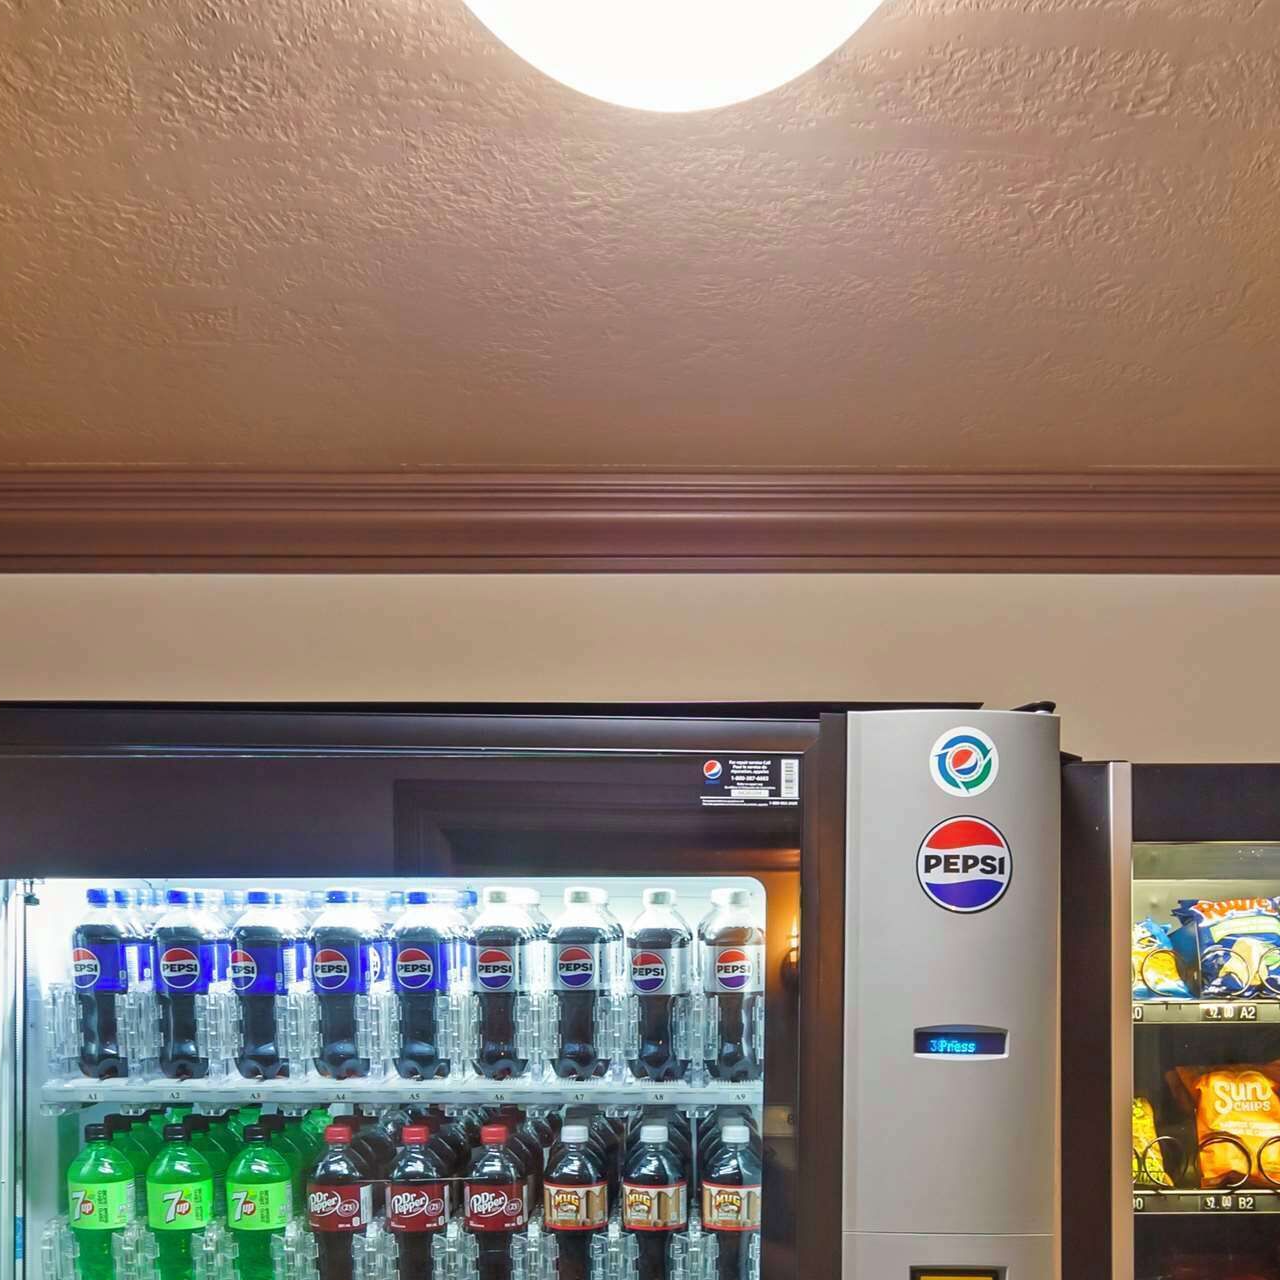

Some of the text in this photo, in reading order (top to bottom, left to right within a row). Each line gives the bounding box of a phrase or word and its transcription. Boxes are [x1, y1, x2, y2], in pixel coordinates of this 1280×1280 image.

[924, 855, 1005, 875] PEPSI
[162, 963, 198, 973] PEPSI
[314, 964, 348, 974] PEPSI
[397, 963, 431, 973] PEPSI
[478, 964, 512, 974] PEPSI
[559, 962, 593, 972] PEPSI
[632, 966, 664, 977] PEPSI
[1240, 1007, 1256, 1018] A2
[1213, 1079, 1272, 1115] Sun
[1233, 1101, 1272, 1113] CHIPS
[1238, 1197, 1254, 1208] B2
